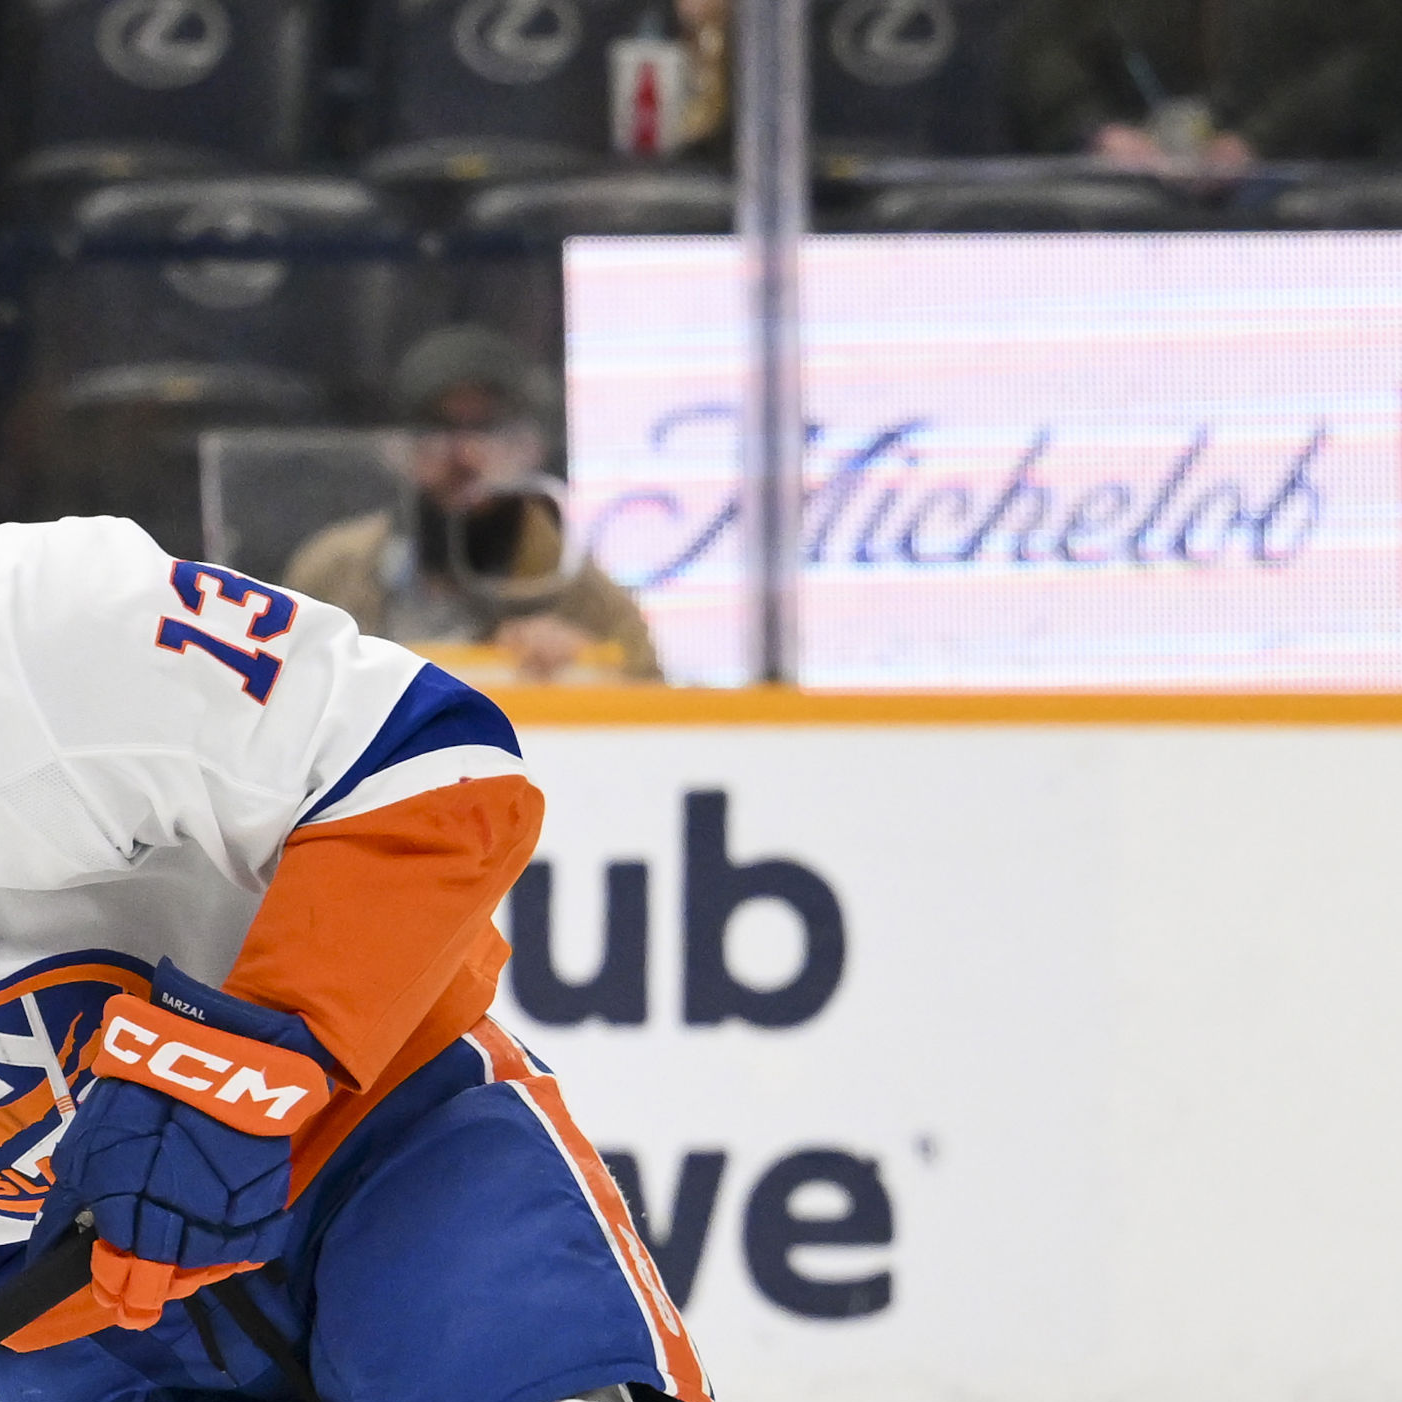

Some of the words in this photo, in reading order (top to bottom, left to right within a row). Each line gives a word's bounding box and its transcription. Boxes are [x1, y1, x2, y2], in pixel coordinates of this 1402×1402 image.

[590, 402, 1332, 590] Michelob
[155, 559, 298, 706] 13
[506, 788, 846, 1029] ub
[104, 1016, 310, 1120] CCM
[162, 992, 206, 1021] BARZAL
